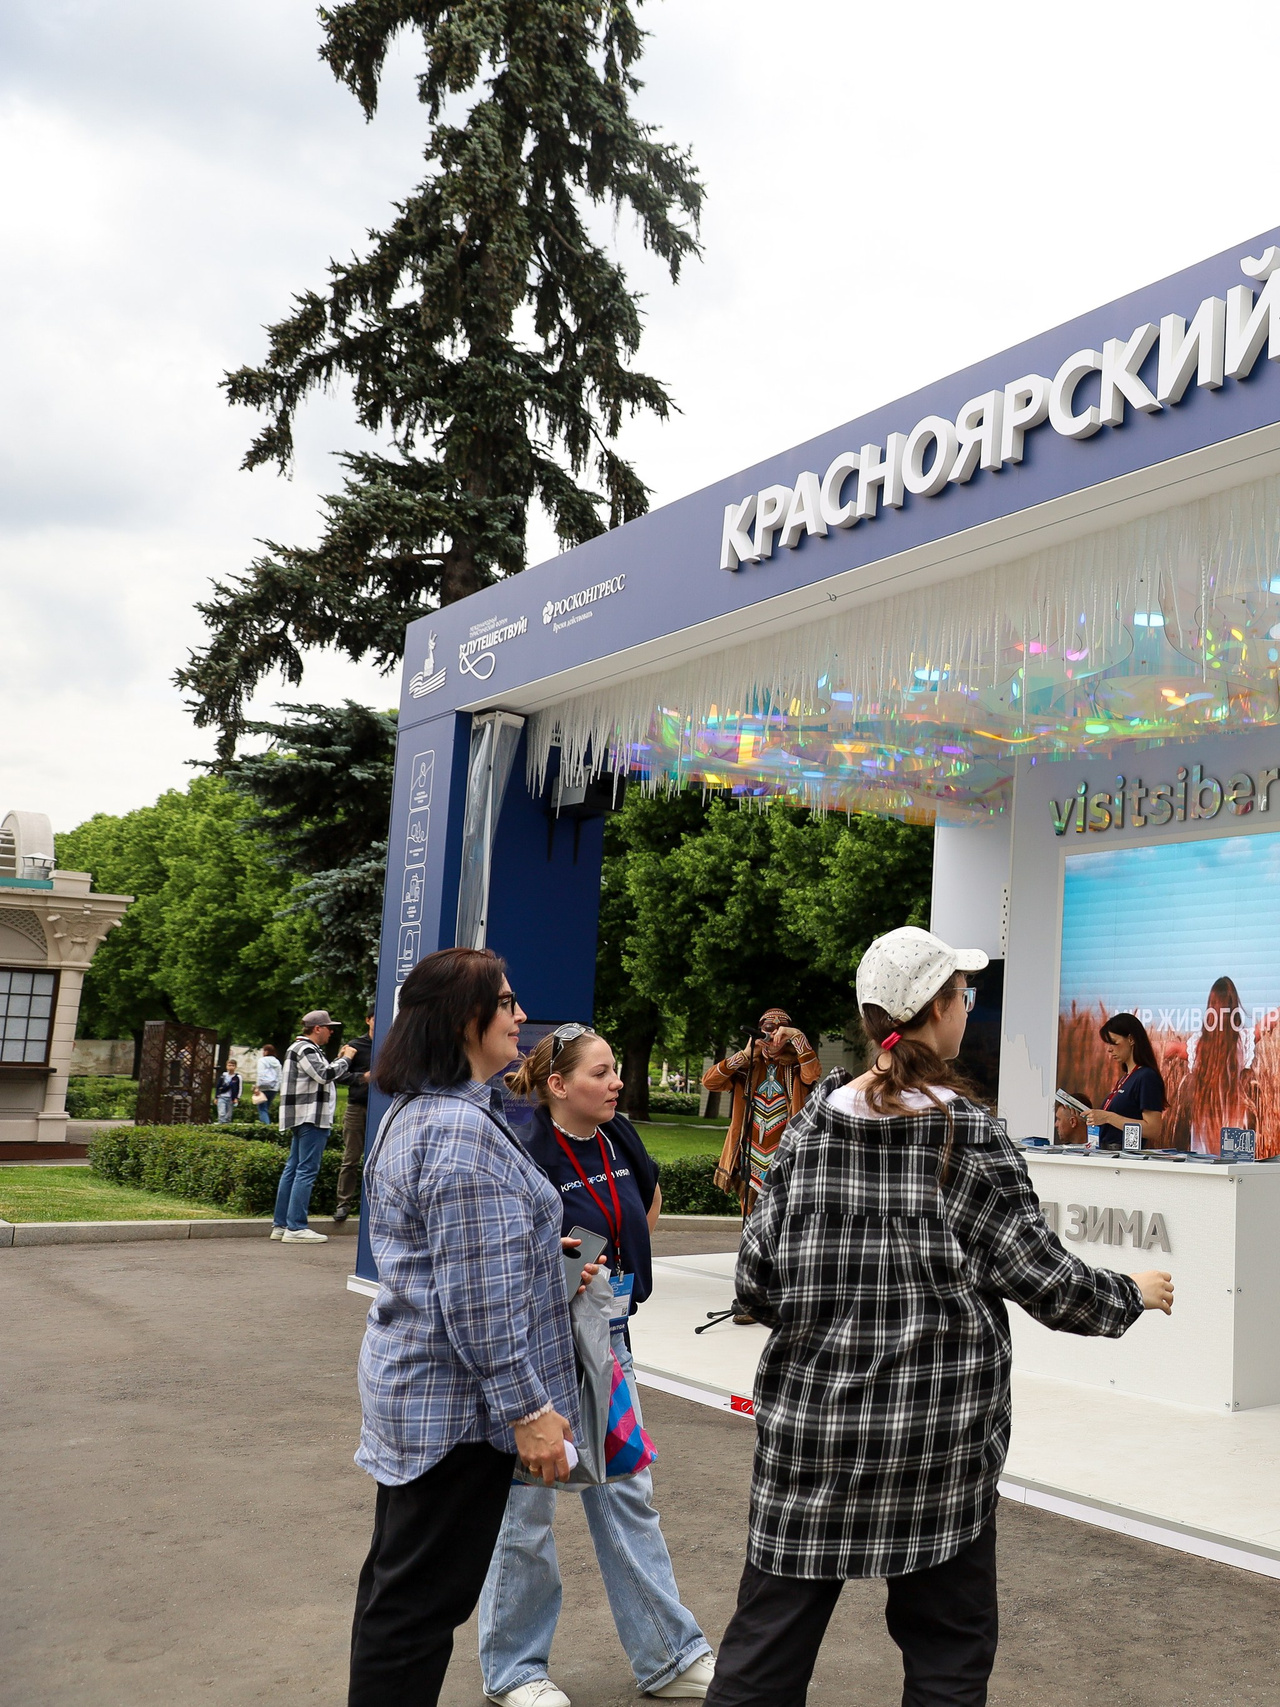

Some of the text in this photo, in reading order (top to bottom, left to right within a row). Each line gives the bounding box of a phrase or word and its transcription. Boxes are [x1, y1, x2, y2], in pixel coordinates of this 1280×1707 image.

[553, 573, 626, 618] РОСКОНГРЕСС
[464, 616, 528, 656] ПУТЕШЕСТВУЙ!
[1156, 1006, 1246, 1032] ЖИВОГО
[1065, 1203, 1172, 1252] ЗИМА
